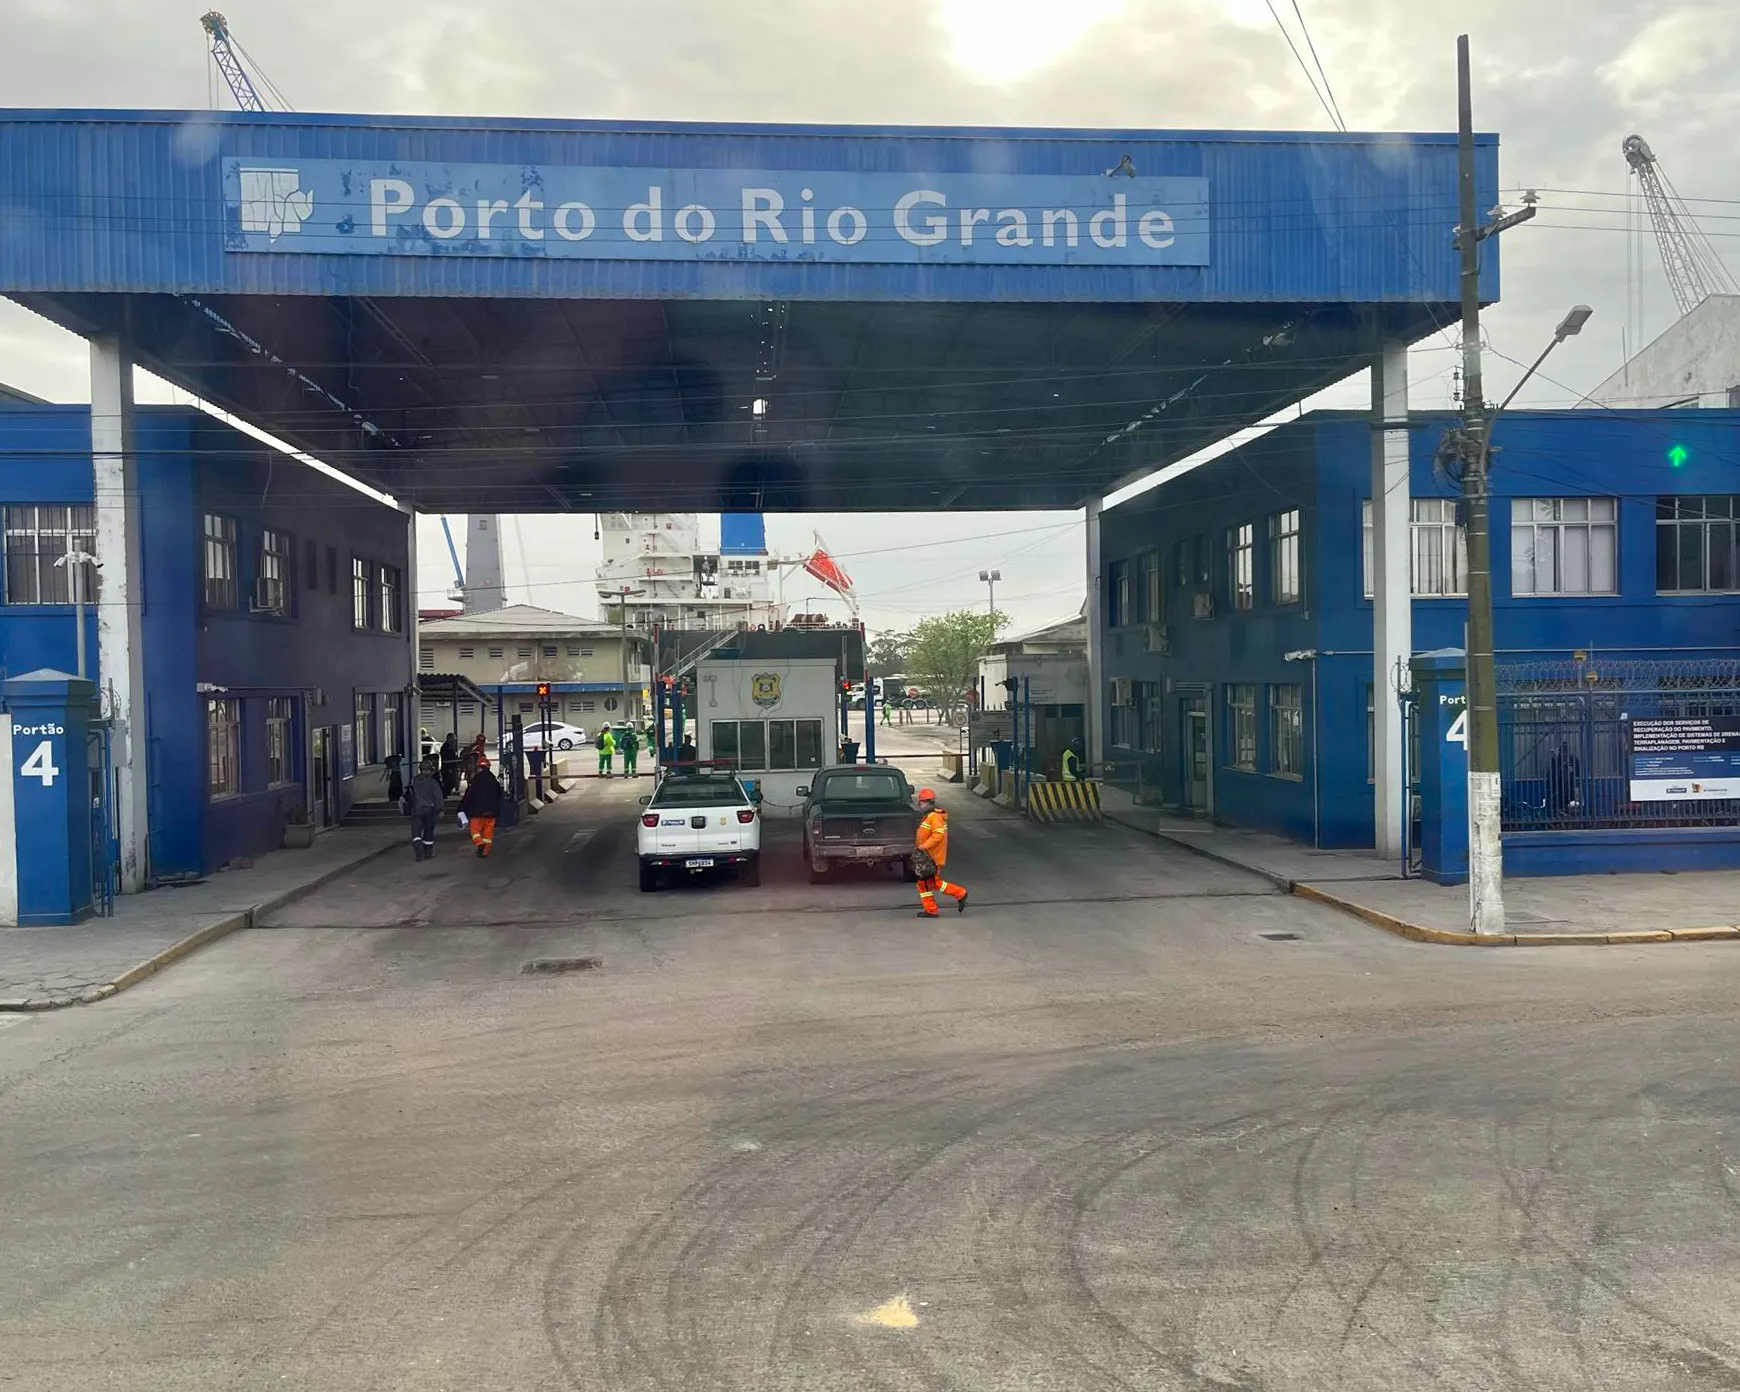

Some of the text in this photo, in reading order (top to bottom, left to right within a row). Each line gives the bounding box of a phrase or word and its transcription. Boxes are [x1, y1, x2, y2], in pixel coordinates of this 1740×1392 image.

[370, 178, 1175, 249] Porto do Rio Grande
[1440, 695, 1466, 705] Port
[13, 723, 64, 735] Portão
[1446, 709, 1468, 751] 4
[21, 740, 59, 786] 4
